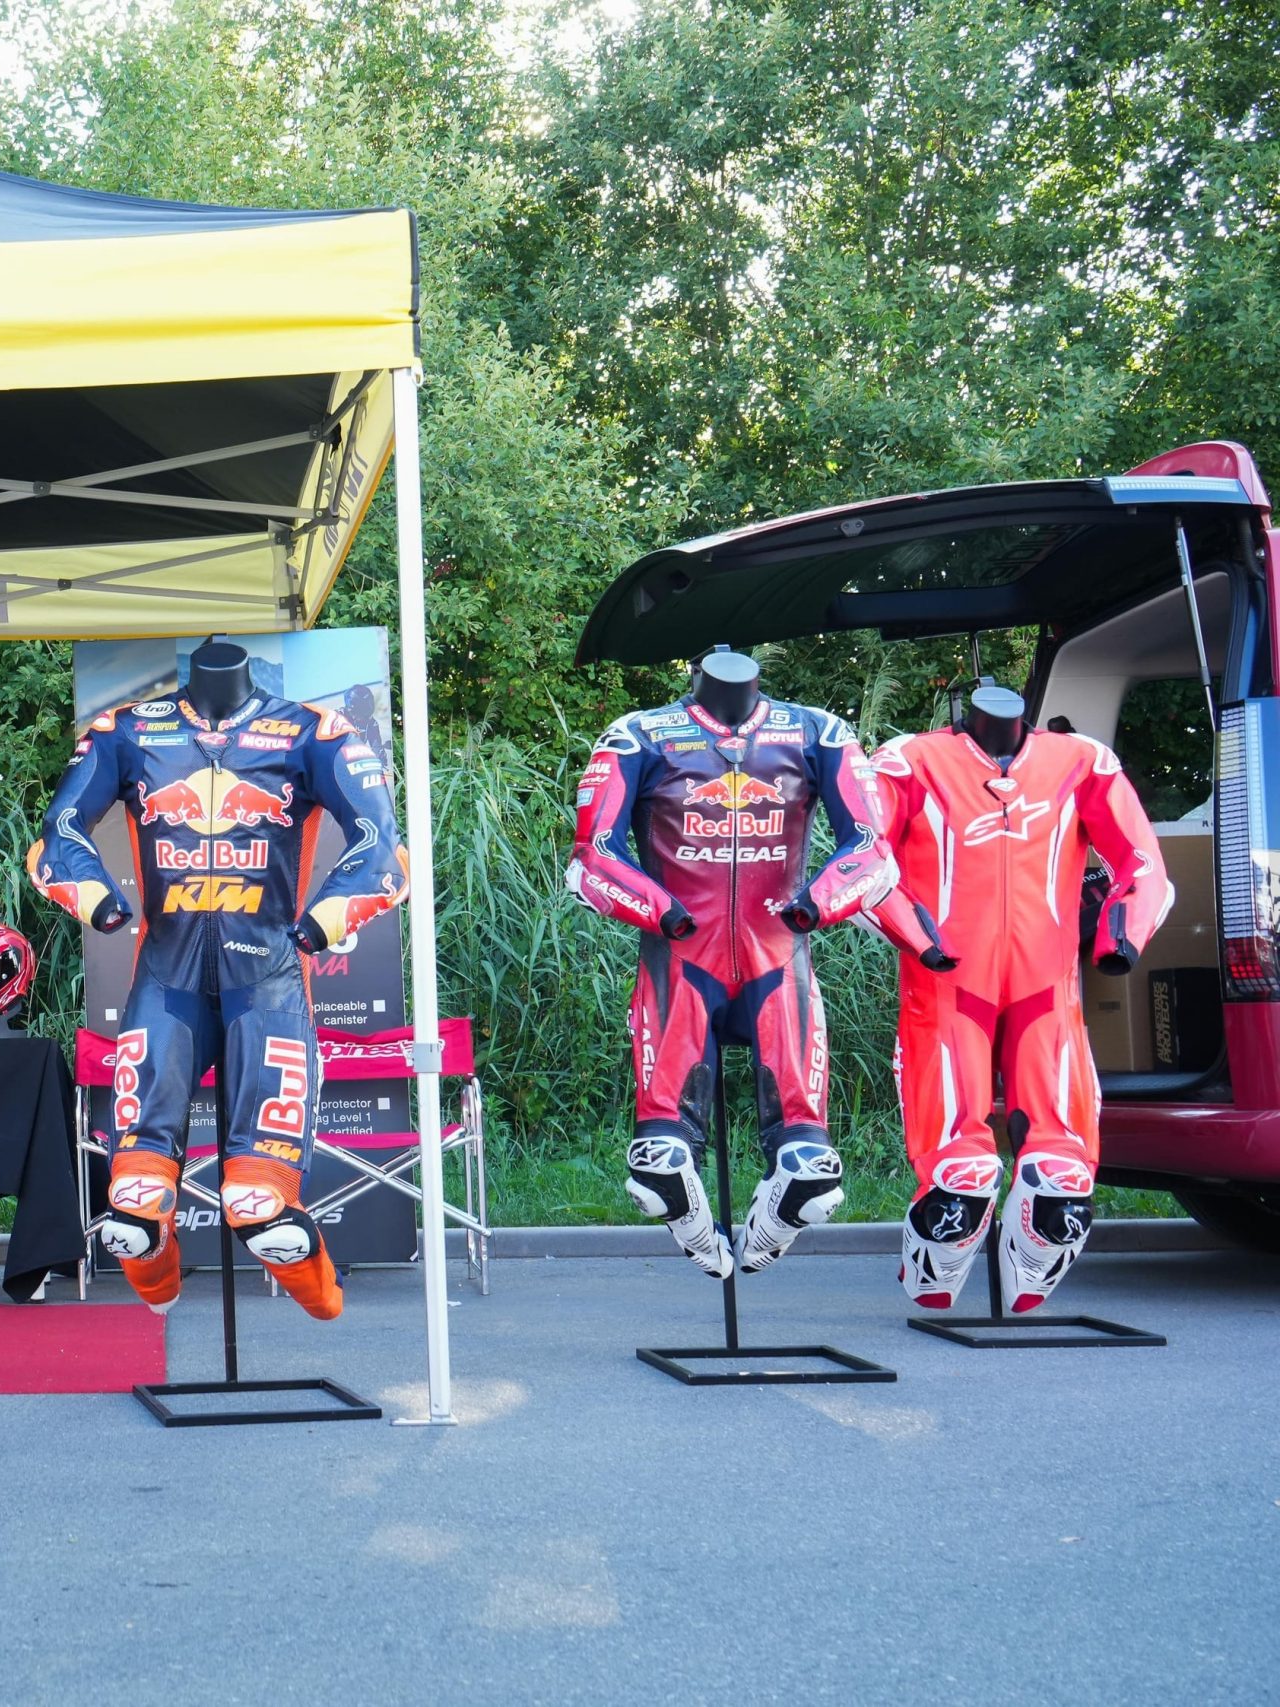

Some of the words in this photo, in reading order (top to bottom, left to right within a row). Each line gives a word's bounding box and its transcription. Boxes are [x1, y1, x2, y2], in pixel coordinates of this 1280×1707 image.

[247, 718, 302, 737] KTM
[691, 705, 726, 734] GASGAS
[762, 722, 802, 731] GASGAS
[241, 735, 291, 749] MOTUL
[757, 732, 802, 744] MOTUL
[684, 812, 733, 837] Red
[738, 810, 785, 837] Bull
[156, 839, 211, 870] Red
[213, 839, 269, 870] Bull
[675, 845, 787, 864] GASGAS
[162, 876, 264, 913] KTM
[584, 873, 653, 918] GASGAS
[223, 940, 270, 956] MotoGP
[312, 1000, 367, 1013] placeable
[323, 1013, 368, 1026] canister
[256, 1035, 308, 1139] Bull
[320, 1098, 372, 1111] protector
[332, 1112, 362, 1123] Level
[328, 1125, 373, 1135] certified
[252, 1140, 302, 1164] KTM
